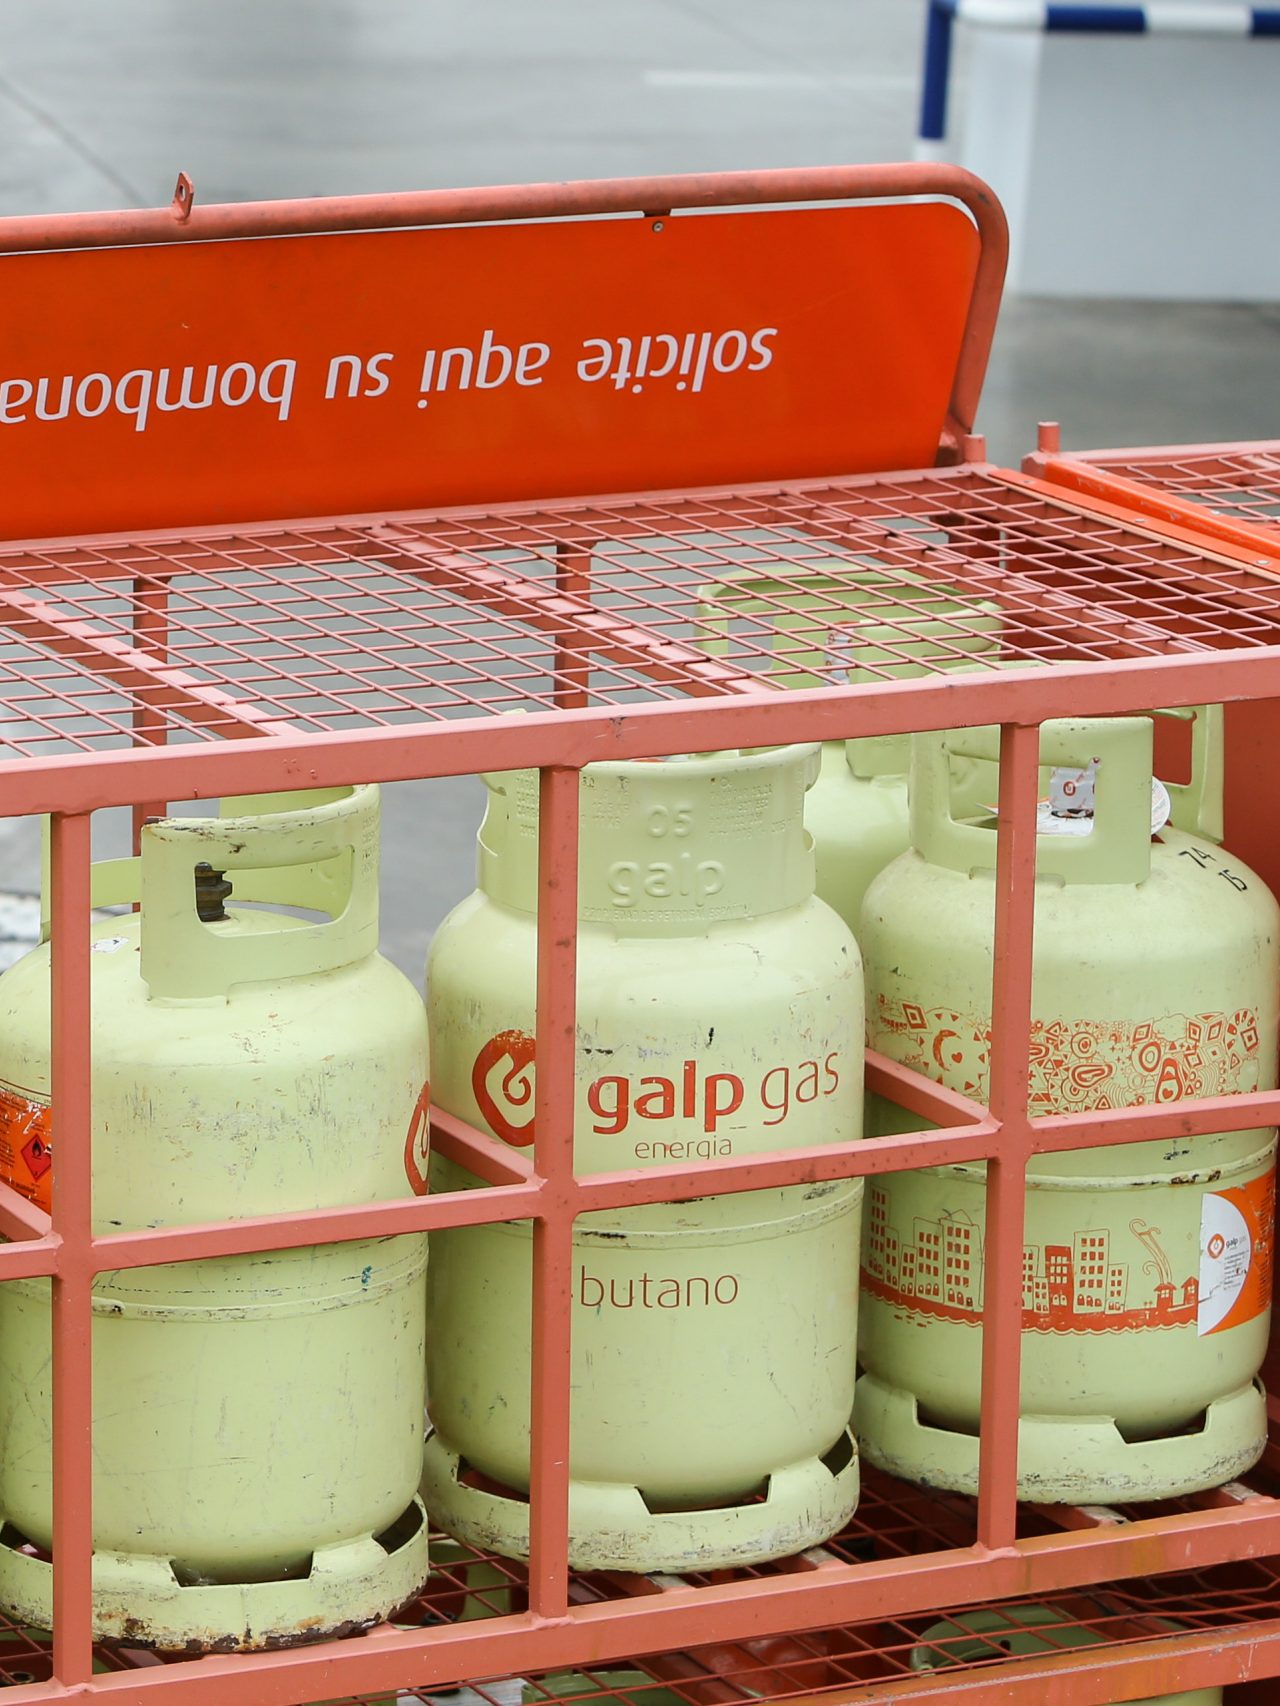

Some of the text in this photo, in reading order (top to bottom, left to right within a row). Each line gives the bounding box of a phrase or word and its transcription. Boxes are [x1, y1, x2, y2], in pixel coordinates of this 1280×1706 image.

[325, 351, 394, 399] su
[419, 329, 550, 409] aqui
[577, 327, 778, 394] solicite
[607, 851, 726, 908] galp
[587, 1052, 839, 1134] galp gas
[634, 1135, 732, 1160] energia
[580, 1264, 739, 1310] butano
